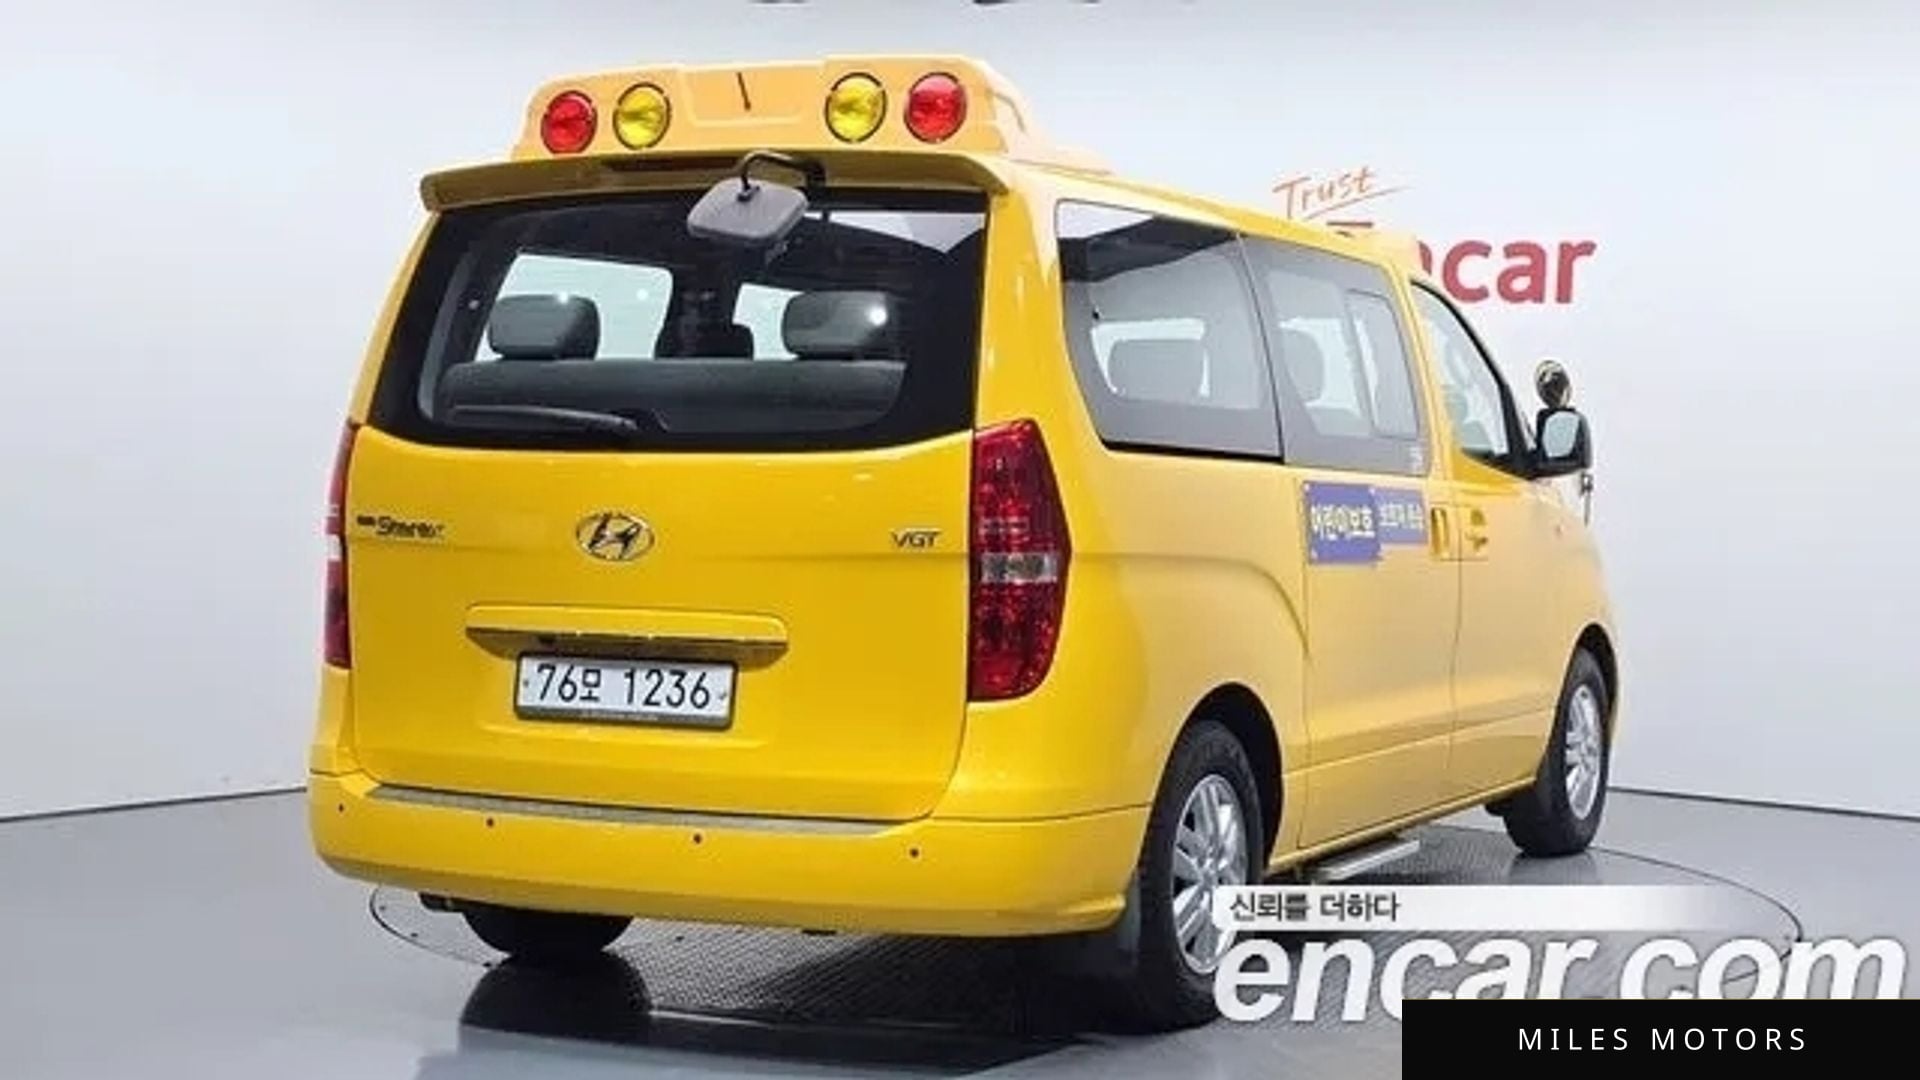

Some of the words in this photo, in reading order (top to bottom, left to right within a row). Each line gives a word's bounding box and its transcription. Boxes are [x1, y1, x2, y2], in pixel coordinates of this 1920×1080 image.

[1273, 166, 1375, 219] Trust
[890, 530, 941, 548] VGT
[537, 663, 602, 703] 76모
[624, 667, 711, 709] 1236
